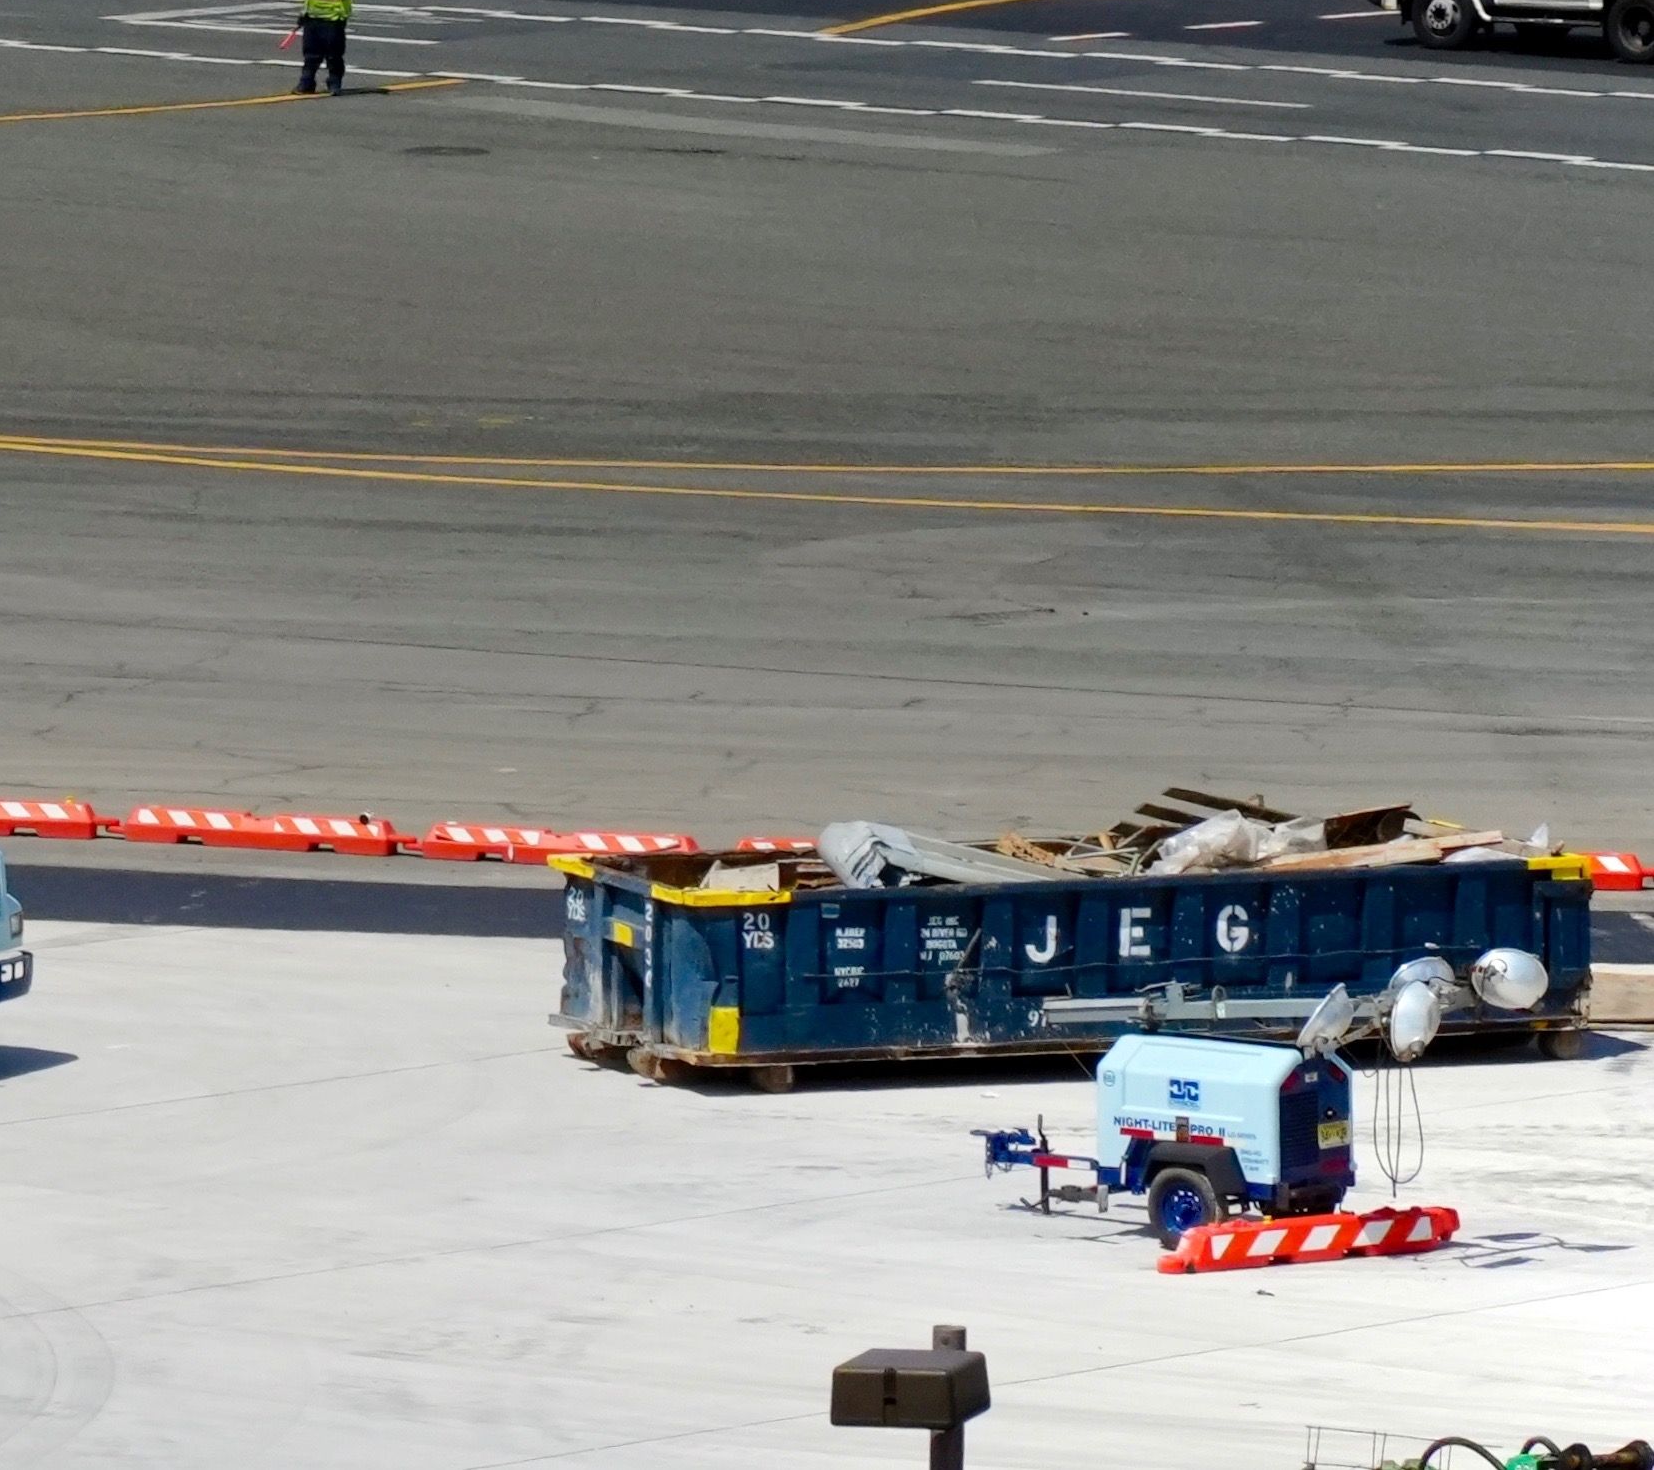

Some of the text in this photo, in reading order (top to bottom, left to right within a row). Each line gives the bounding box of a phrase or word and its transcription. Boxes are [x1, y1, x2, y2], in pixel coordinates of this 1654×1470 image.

[743, 913, 769, 930] 20
[742, 931, 774, 949] YDS
[1114, 1116, 1176, 1132] NIGHT-LITE
[1191, 1126, 1214, 1136] PRO
